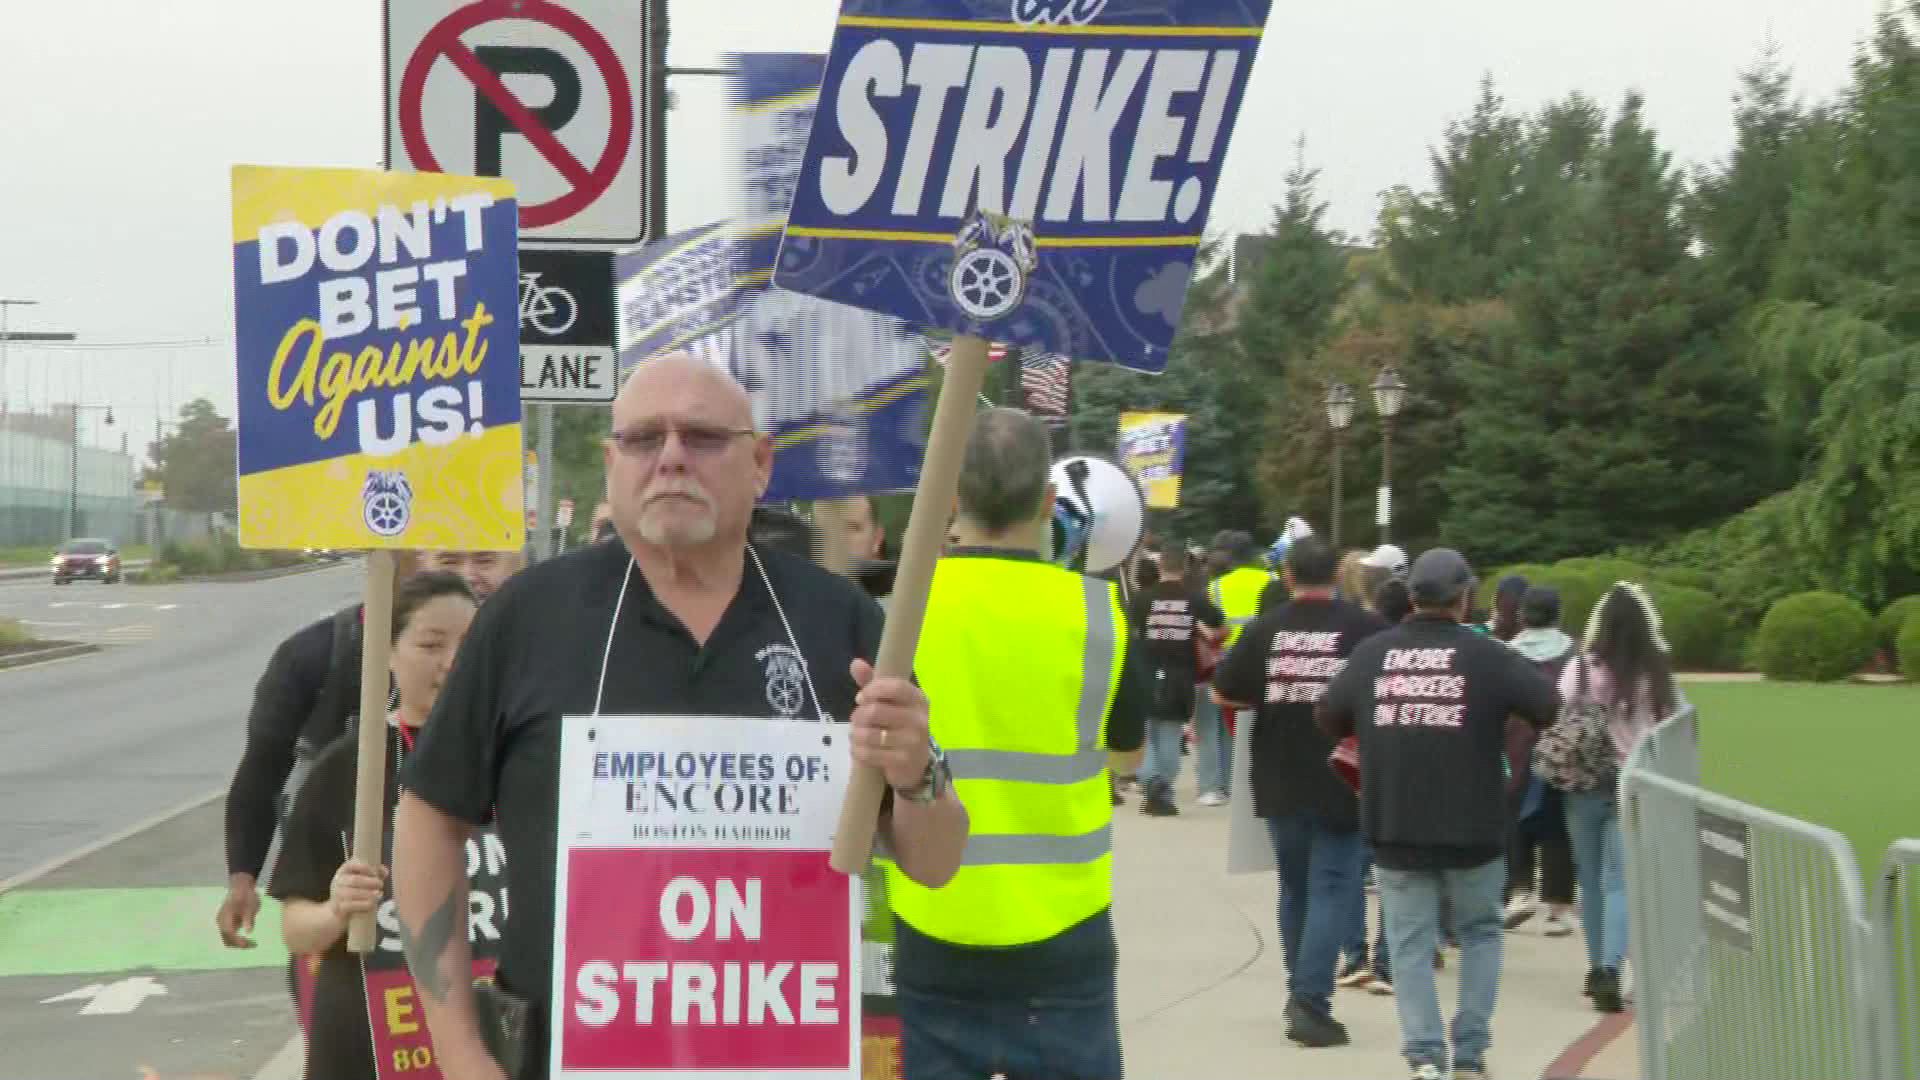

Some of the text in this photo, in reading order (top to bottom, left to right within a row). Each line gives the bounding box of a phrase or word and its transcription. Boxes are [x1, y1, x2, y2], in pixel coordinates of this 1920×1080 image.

[819, 38, 1240, 225] STRIKE!
[257, 191, 495, 286] DON'T
[318, 259, 468, 340] BET
[267, 301, 495, 440] Against
[520, 354, 602, 390] LANE
[357, 380, 486, 457] US!
[1382, 647, 1457, 671] ENCORE
[1398, 702, 1468, 728] STRIKE
[593, 750, 829, 783] EMPLOYEES OF:
[625, 781, 800, 815] ENCORE
[632, 823, 792, 841] BOSTON HARBOR
[659, 875, 762, 942] ON
[574, 959, 840, 1028] STRIKE
